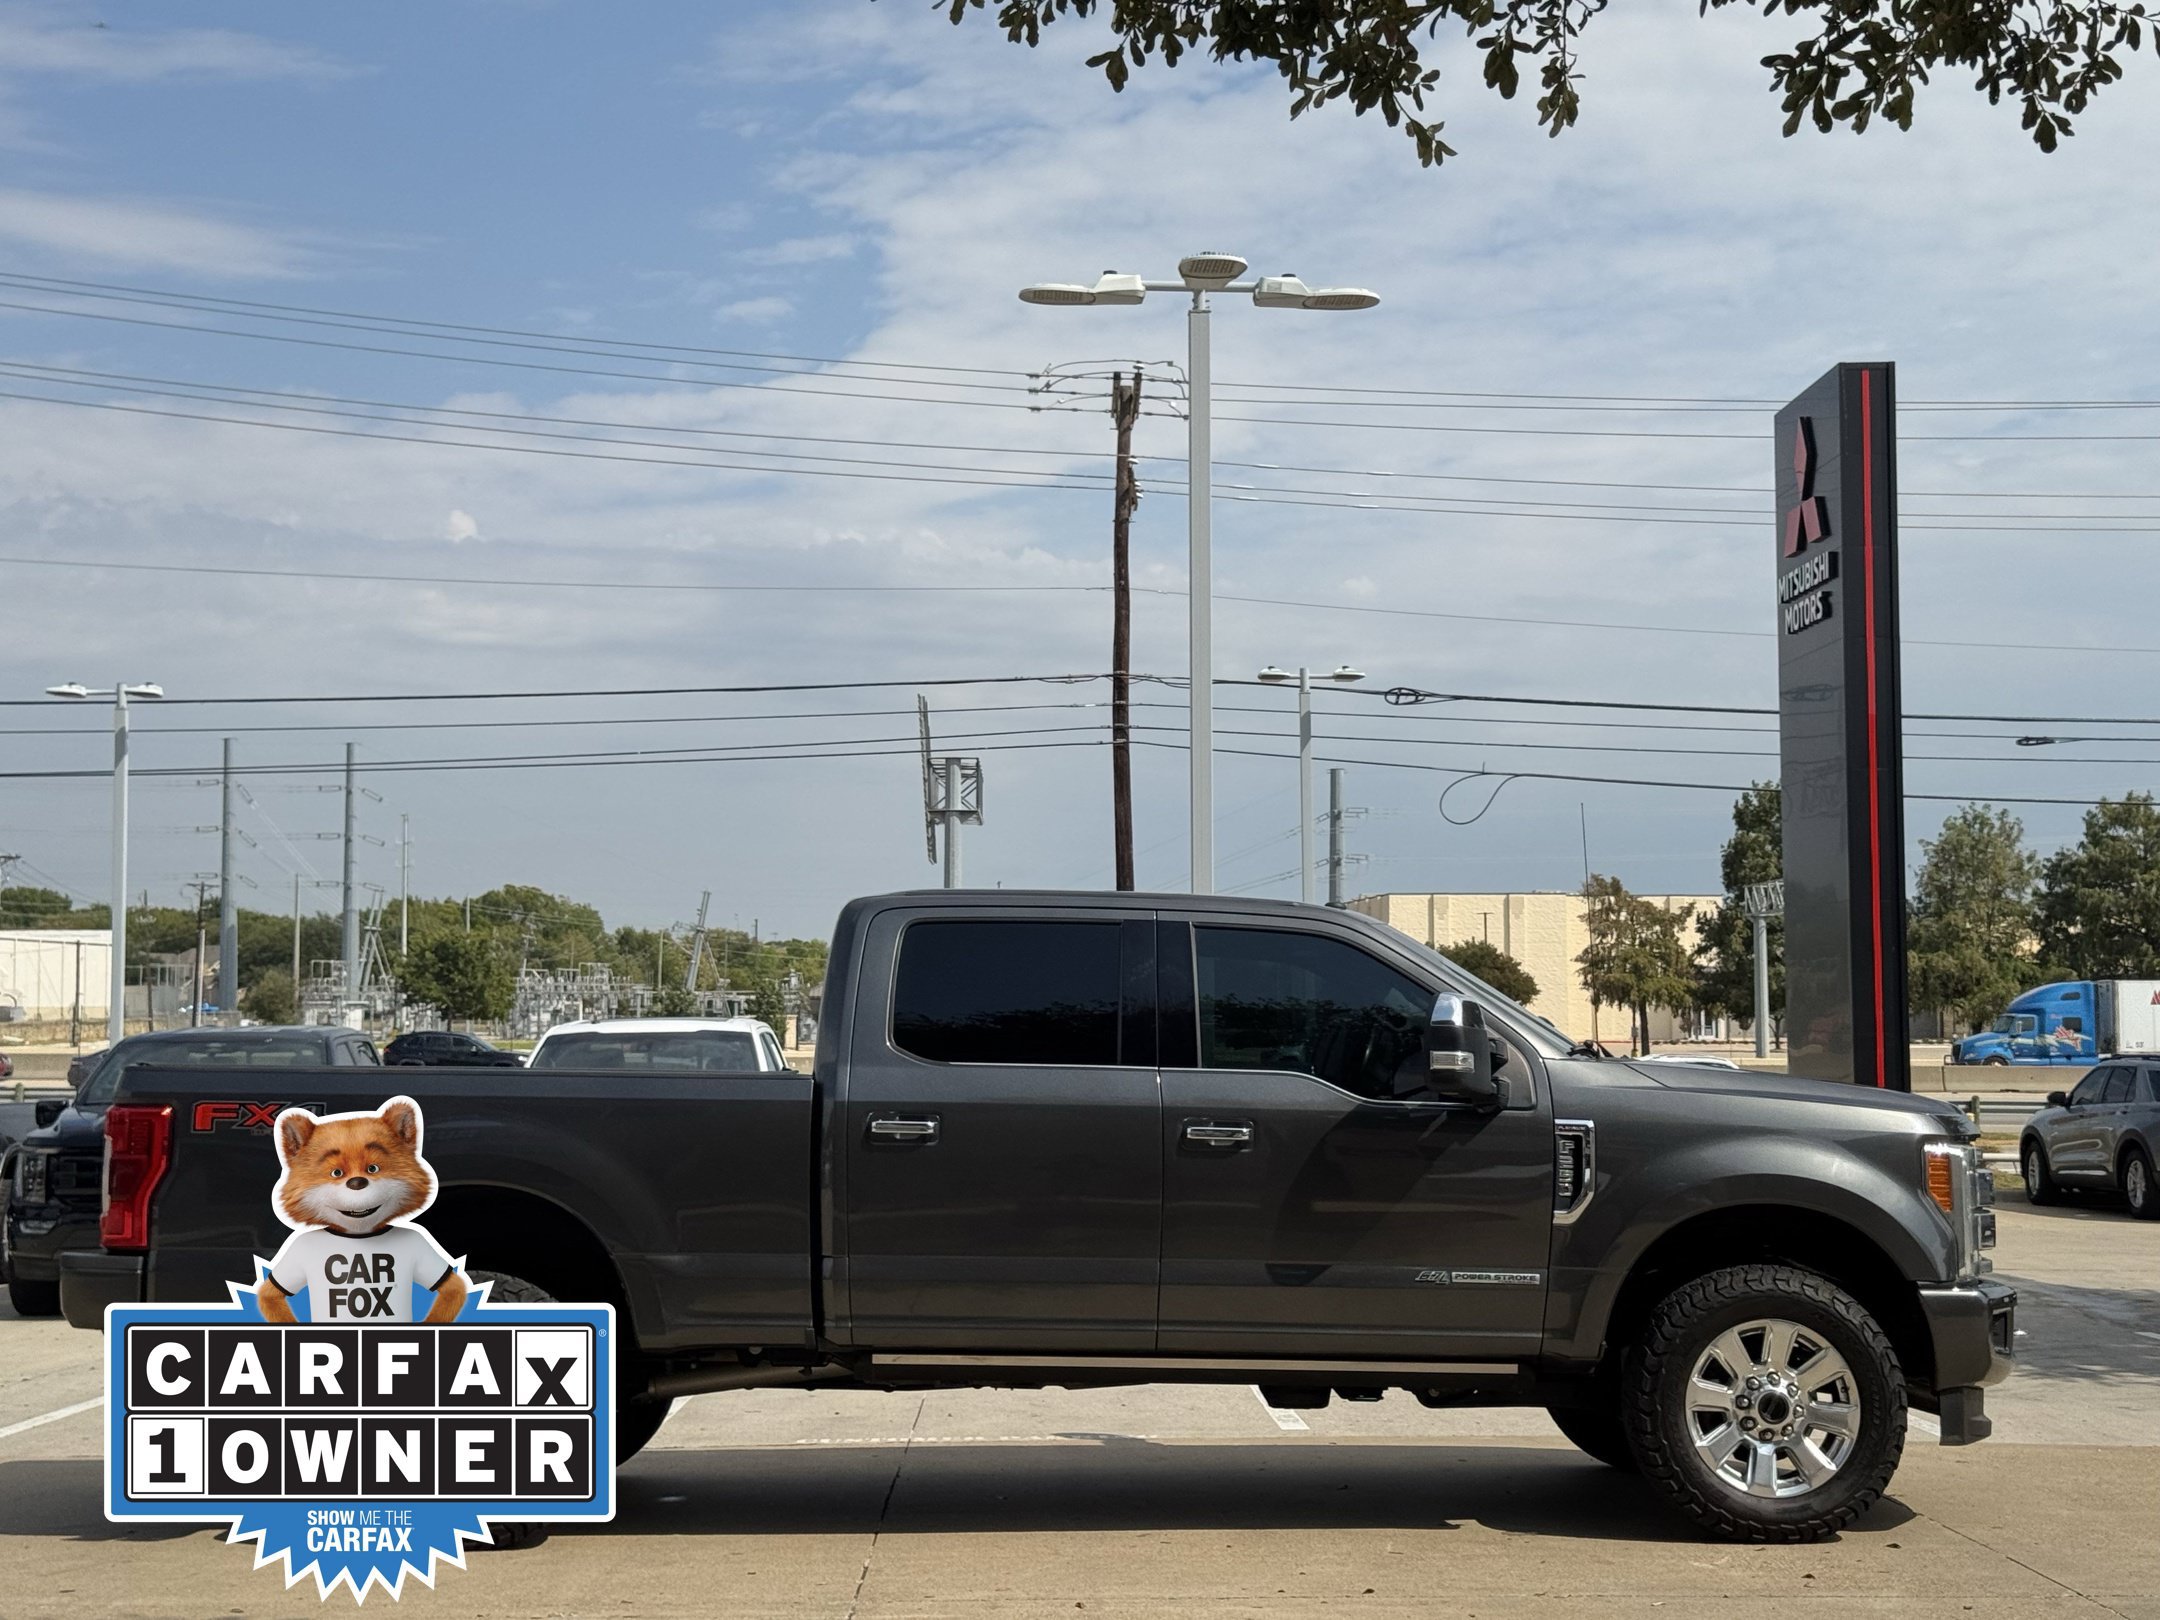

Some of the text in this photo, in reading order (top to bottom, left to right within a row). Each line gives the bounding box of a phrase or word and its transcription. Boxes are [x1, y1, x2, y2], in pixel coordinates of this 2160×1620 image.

[1779, 551, 1829, 604] MITSUBISHI
[1785, 591, 1823, 635] MOTORS
[191, 1101, 327, 1134] FX
[1454, 1273, 1492, 1281] POWER
[1494, 1274, 1538, 1282] STROKE
